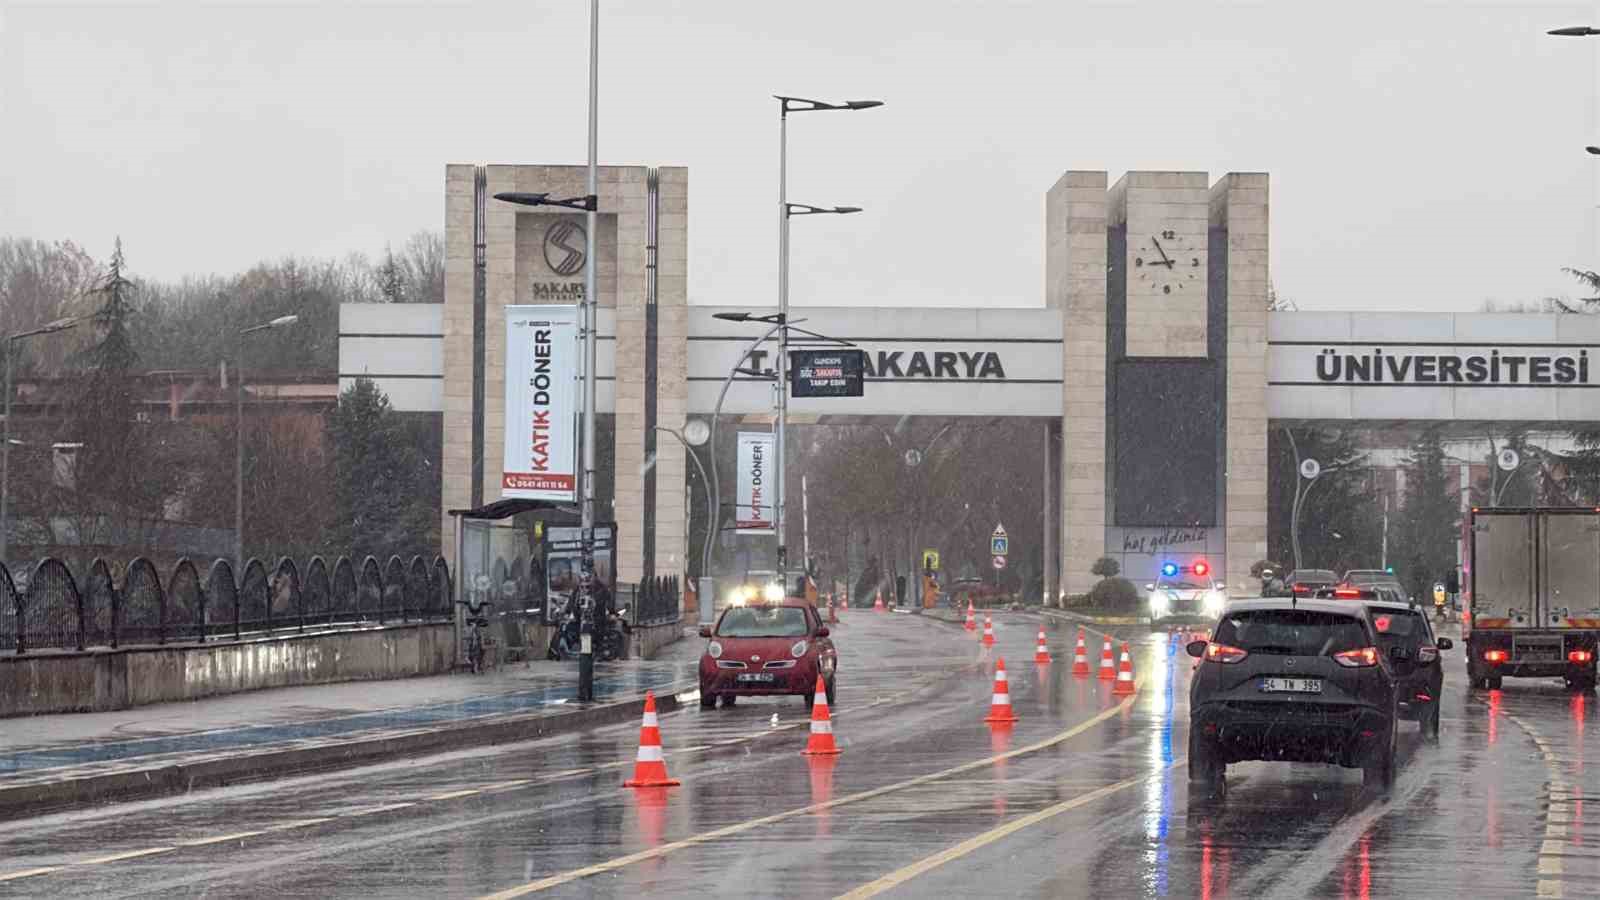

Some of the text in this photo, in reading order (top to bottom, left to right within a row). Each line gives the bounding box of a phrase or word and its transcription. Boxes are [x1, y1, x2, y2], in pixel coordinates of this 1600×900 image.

[1162, 230, 1175, 240] 12
[1136, 257, 1143, 267] 9
[1191, 257, 1199, 267] 3
[1163, 285, 1170, 294] 6
[529, 329, 552, 406] DÖNER
[1316, 348, 1589, 383] ÜNİVERSİTESİ
[531, 410, 550, 471] KATIK
[751, 445, 763, 520] KATIK DÖNER
